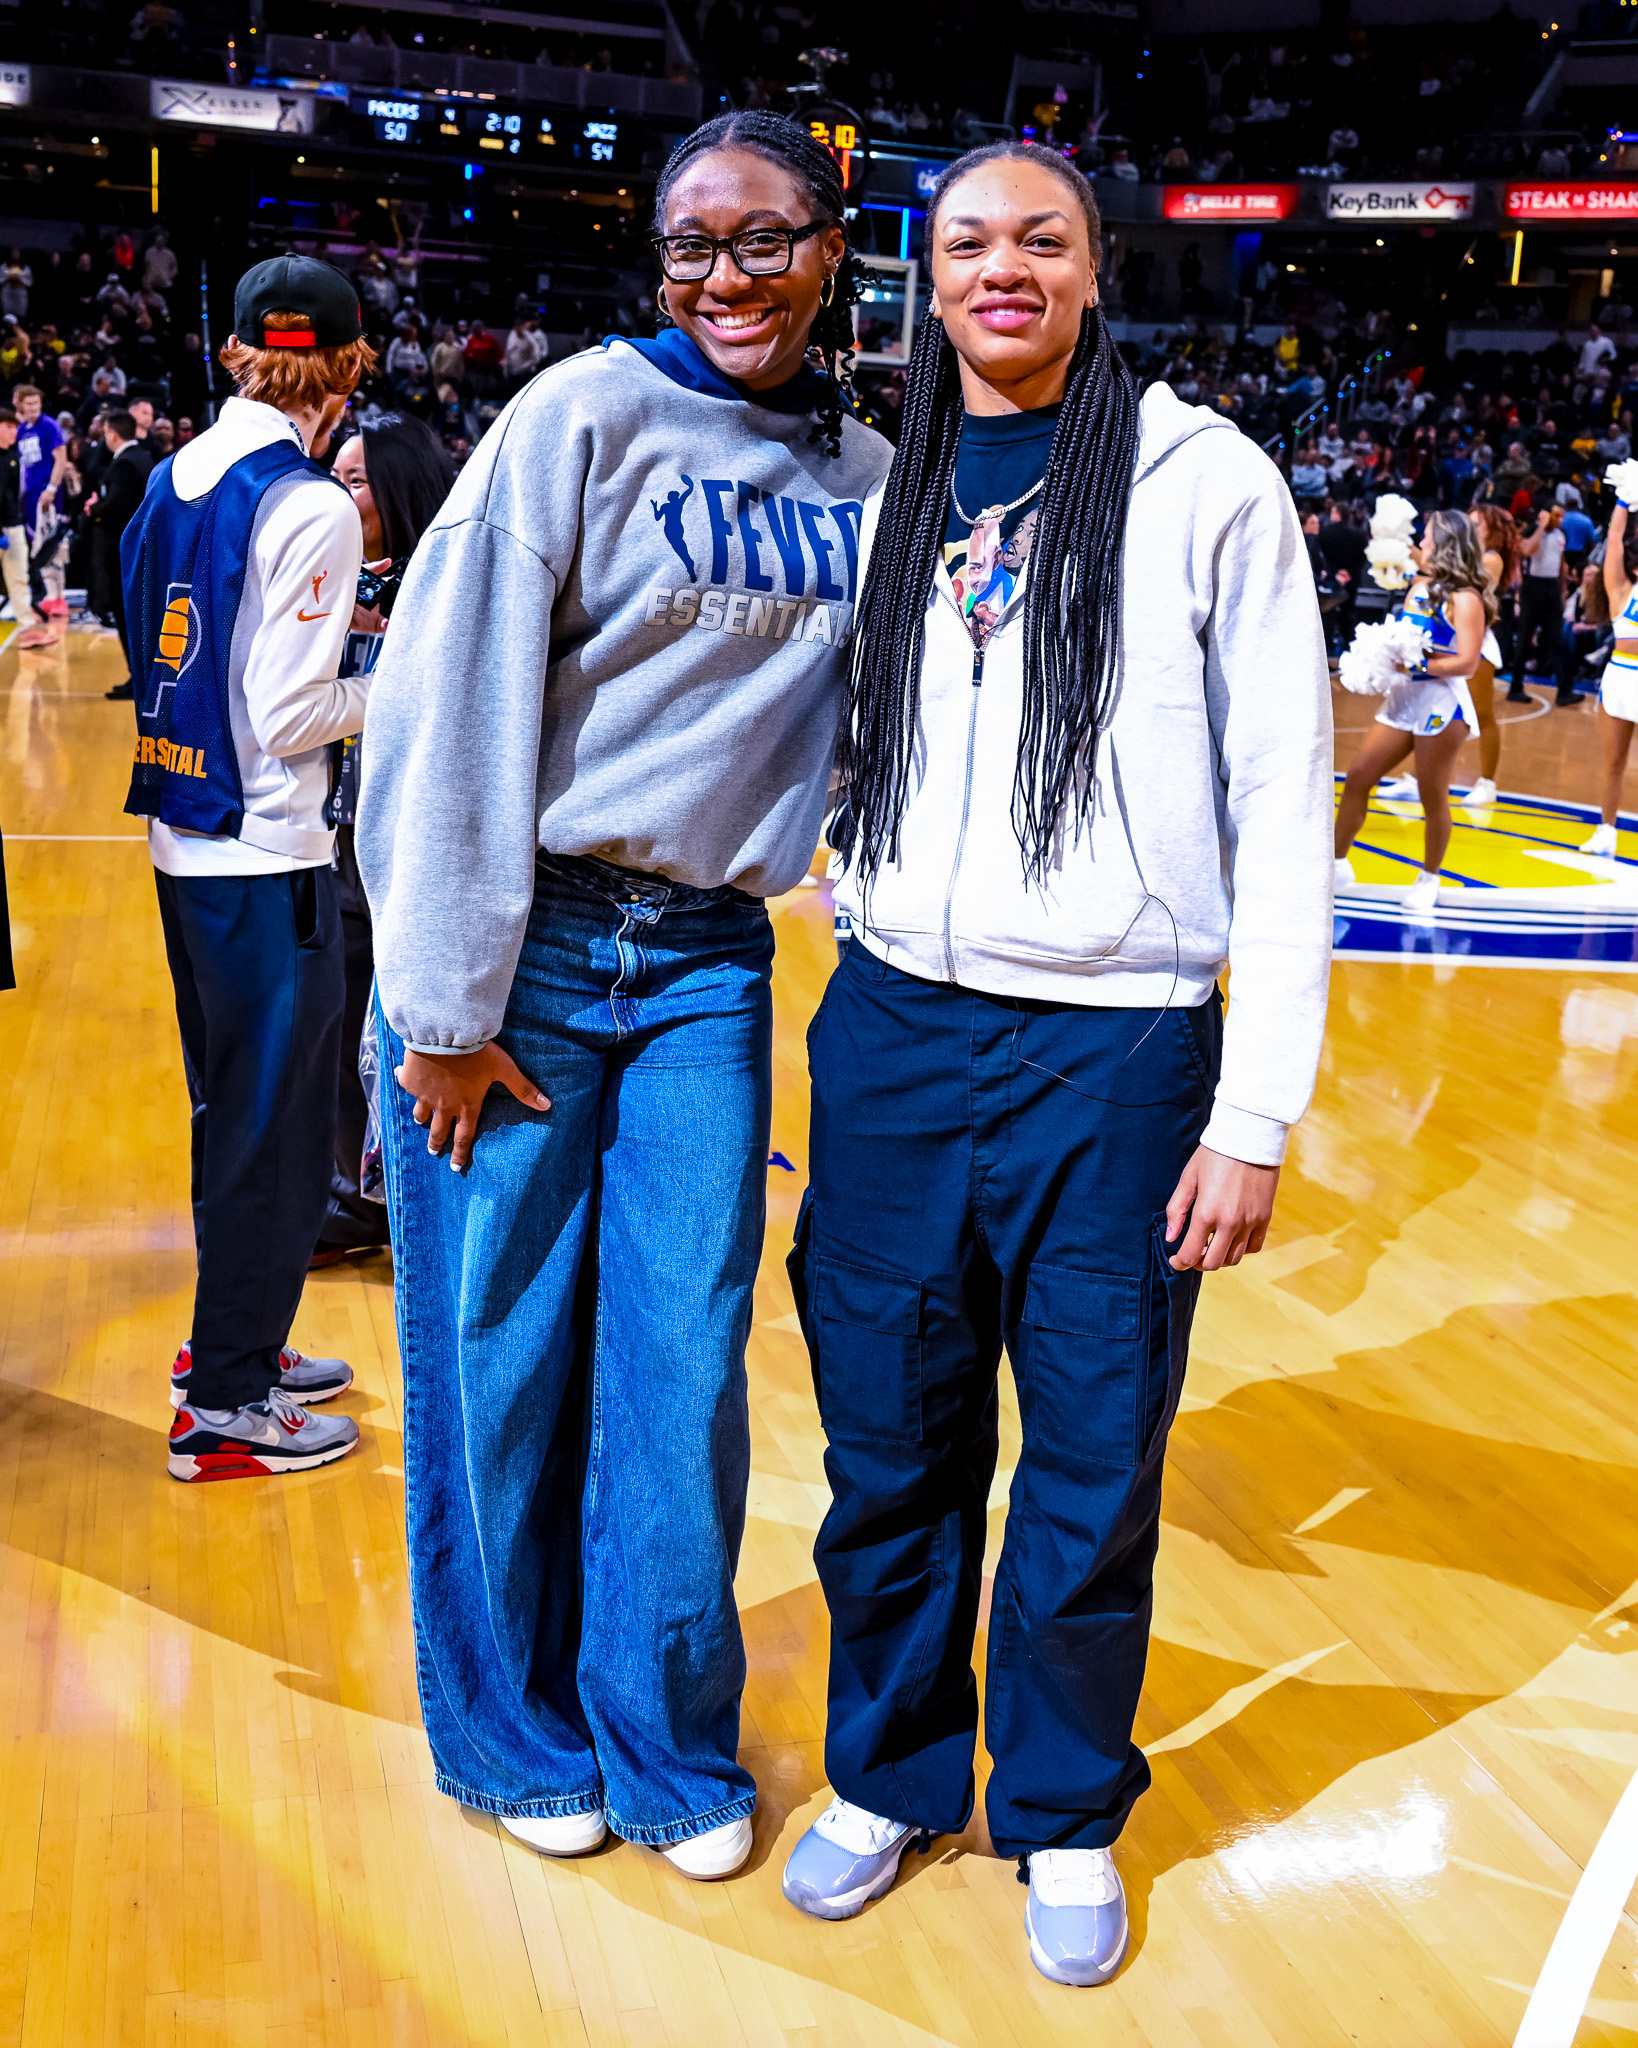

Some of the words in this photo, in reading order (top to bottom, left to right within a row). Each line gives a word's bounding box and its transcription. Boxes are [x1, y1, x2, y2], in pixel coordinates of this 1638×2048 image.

[368, 100, 420, 120] PACERS
[384, 121, 407, 141] 50
[486, 113, 521, 134] 2:10
[583, 122, 618, 140] JAZZ
[810, 122, 855, 149] 2:10
[591, 142, 613, 161] 54
[1329, 192, 1418, 213] KeyBank
[1509, 191, 1571, 209] STEAK
